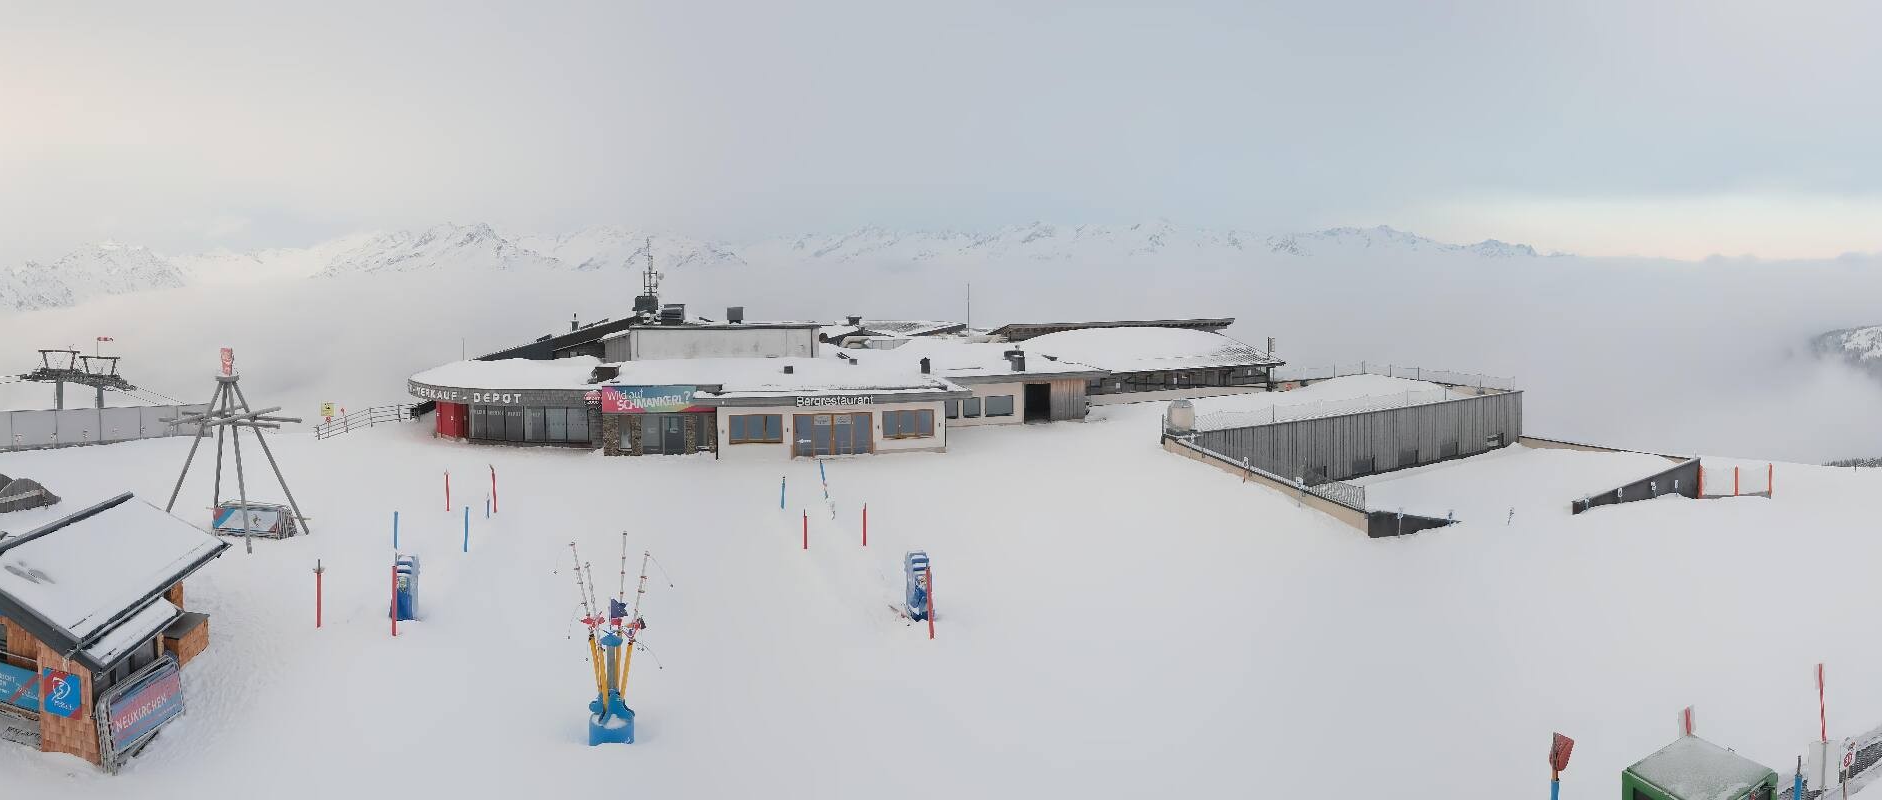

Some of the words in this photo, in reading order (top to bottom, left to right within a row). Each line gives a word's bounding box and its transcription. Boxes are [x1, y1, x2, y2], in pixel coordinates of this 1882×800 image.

[473, 392, 522, 404] DEPOT
[606, 389, 627, 400] Wild
[796, 395, 874, 406] Bergrestaurant
[617, 391, 691, 411] SCHMANKERL?
[115, 692, 167, 733] NEUKIRCHEN
